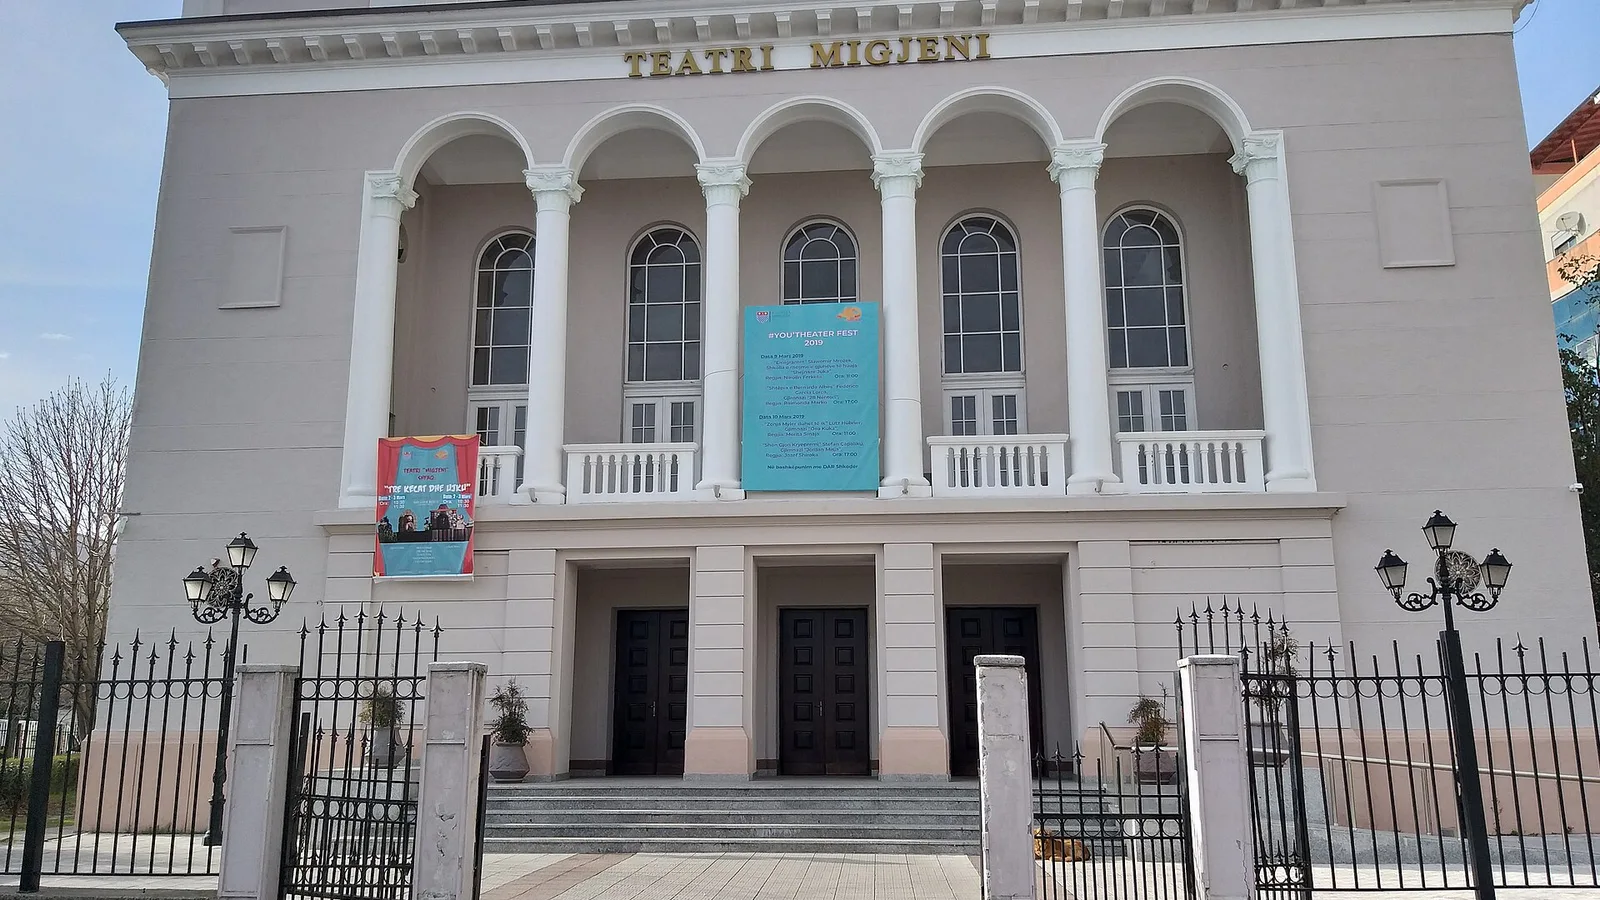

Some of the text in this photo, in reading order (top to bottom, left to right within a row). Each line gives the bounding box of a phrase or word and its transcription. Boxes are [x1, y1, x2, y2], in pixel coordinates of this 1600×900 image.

[624, 33, 991, 78] TEATRI MIGJENI
[768, 330, 834, 339] #YOU'THEATER
[384, 483, 471, 493] "TRE KECAT DHE UJKU"
